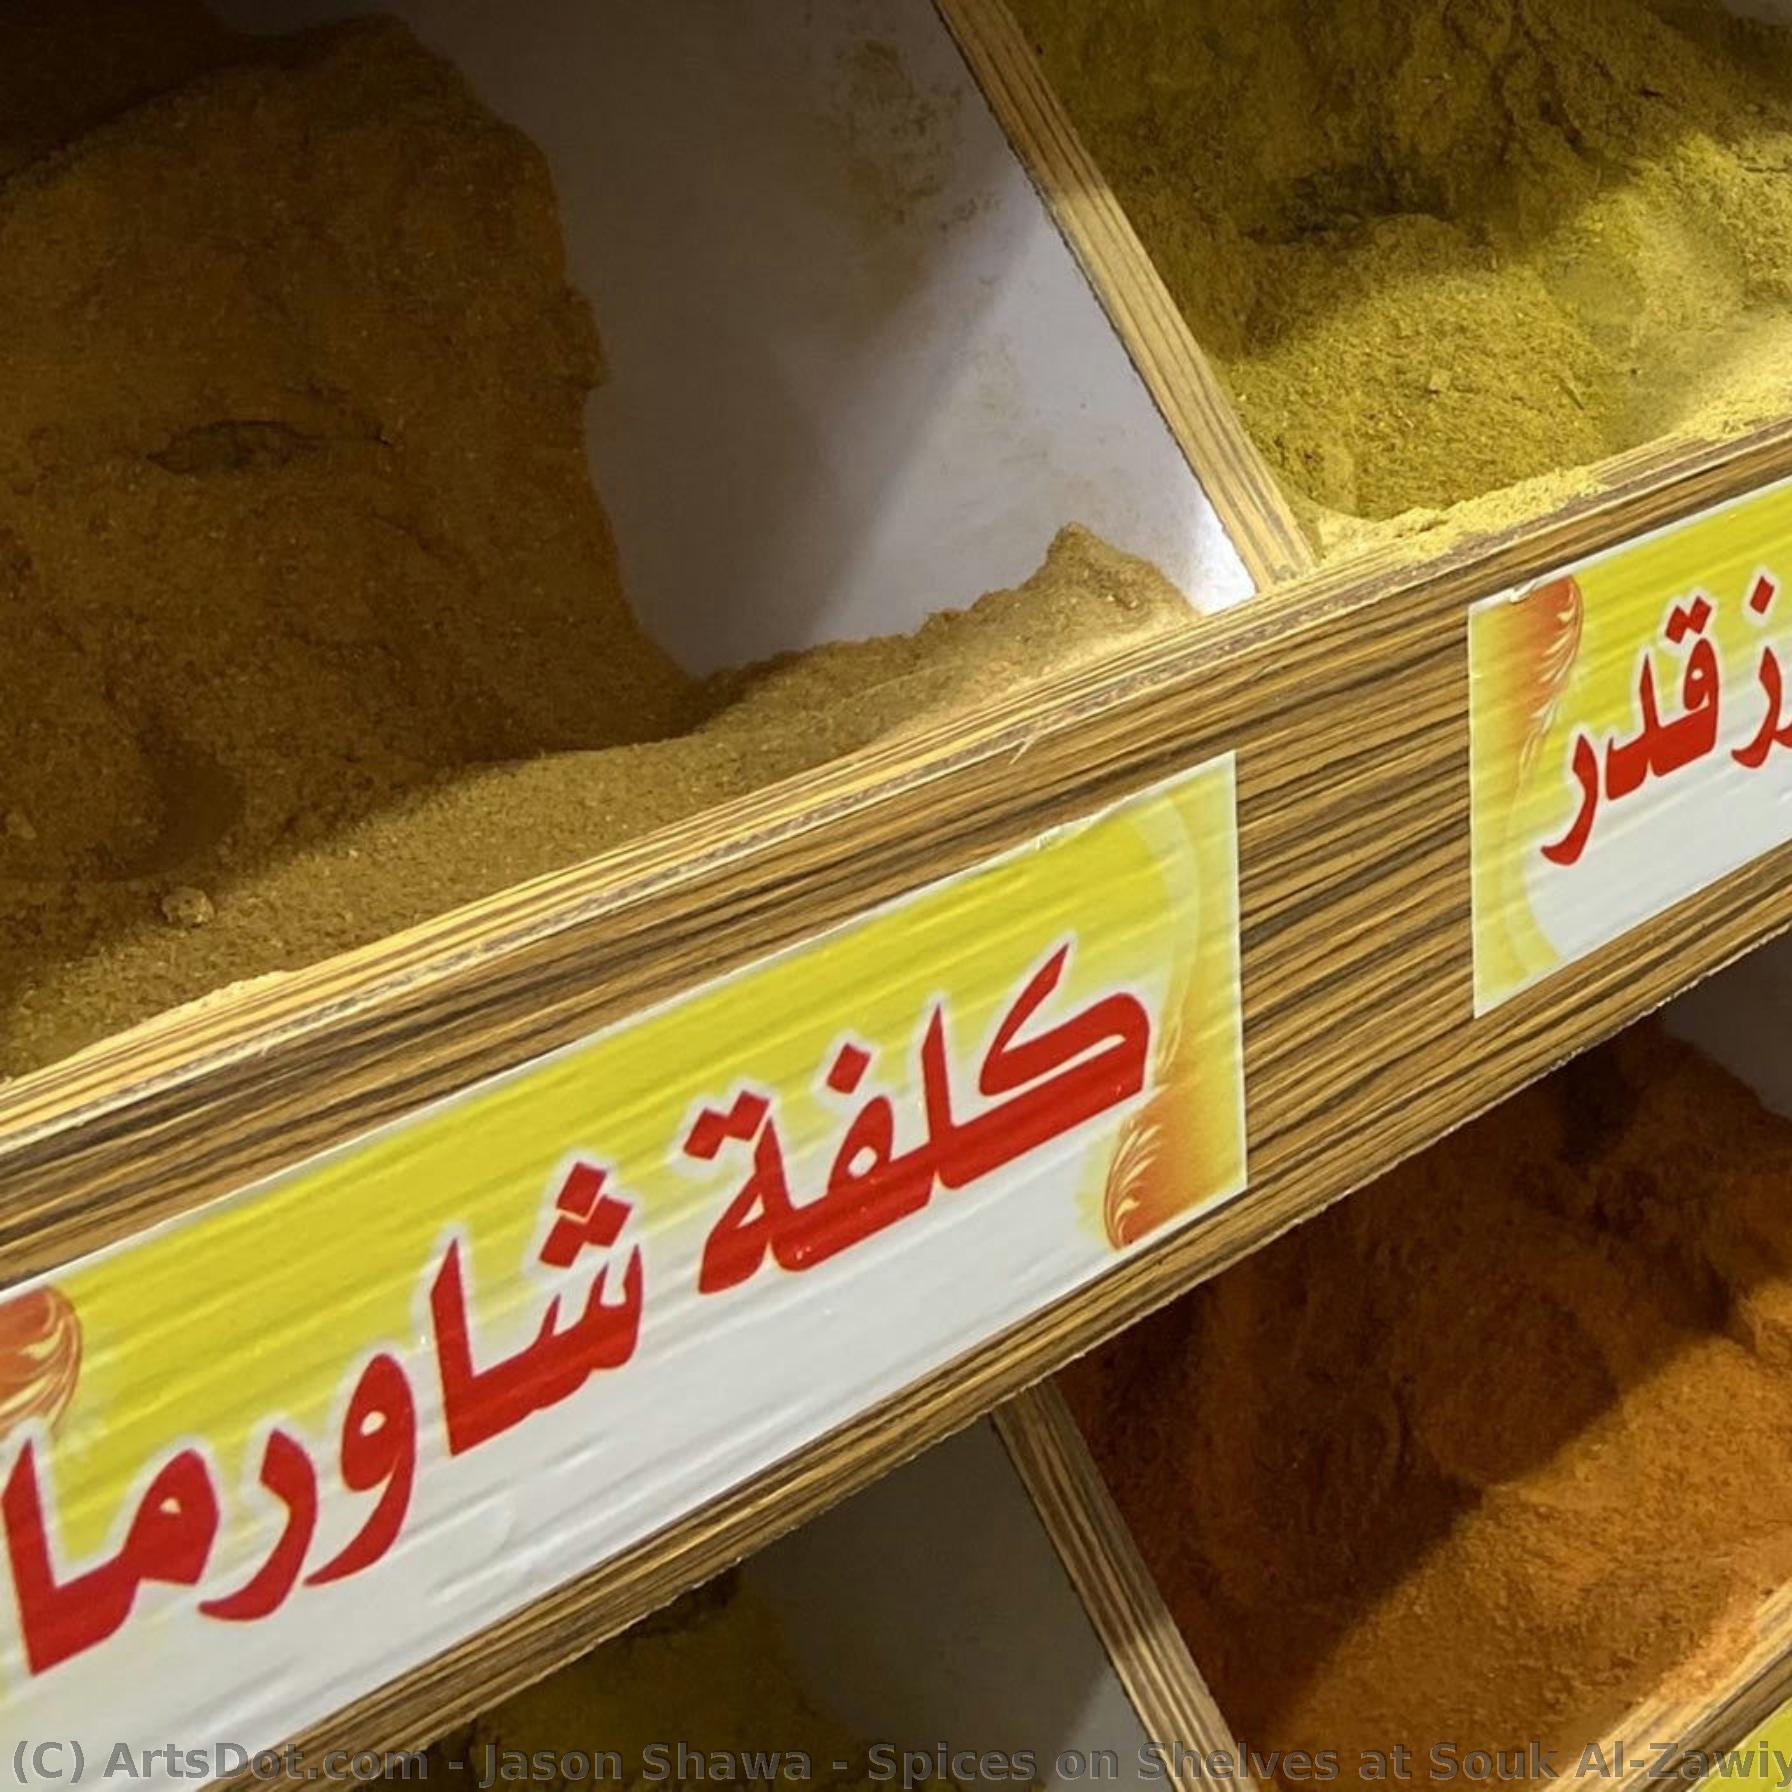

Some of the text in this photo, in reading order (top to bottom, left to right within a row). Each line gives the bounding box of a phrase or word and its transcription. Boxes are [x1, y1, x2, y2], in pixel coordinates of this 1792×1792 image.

[1541, 598, 1719, 866] قدر
[0, 947, 1150, 1675] كلفة شاورما
